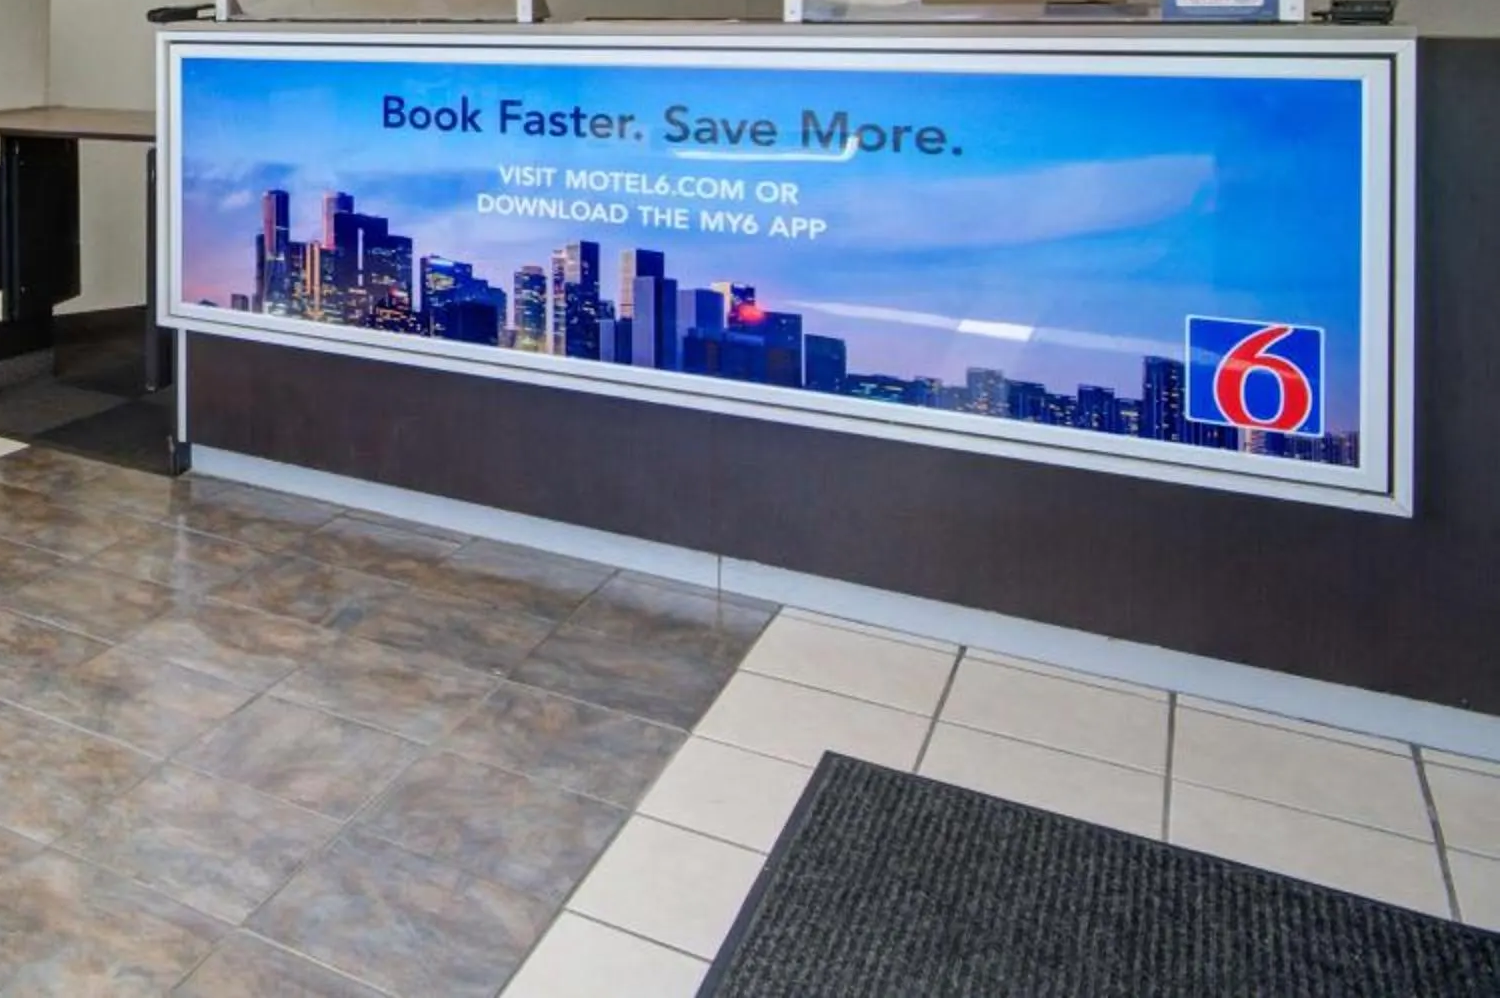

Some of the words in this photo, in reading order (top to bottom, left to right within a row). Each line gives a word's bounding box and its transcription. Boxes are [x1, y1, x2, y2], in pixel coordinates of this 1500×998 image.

[382, 95, 483, 133] Book
[500, 100, 644, 140] Faster.
[663, 104, 779, 147] Save
[801, 109, 963, 156] More.
[498, 164, 557, 188] VISIT
[565, 169, 745, 201] MOTEL6.COM
[755, 180, 799, 205] OR
[476, 193, 629, 224] DOWNLOAD
[638, 204, 690, 230] THE
[700, 210, 759, 236] MY6
[768, 215, 828, 241] APP
[1213, 322, 1313, 434] 6
